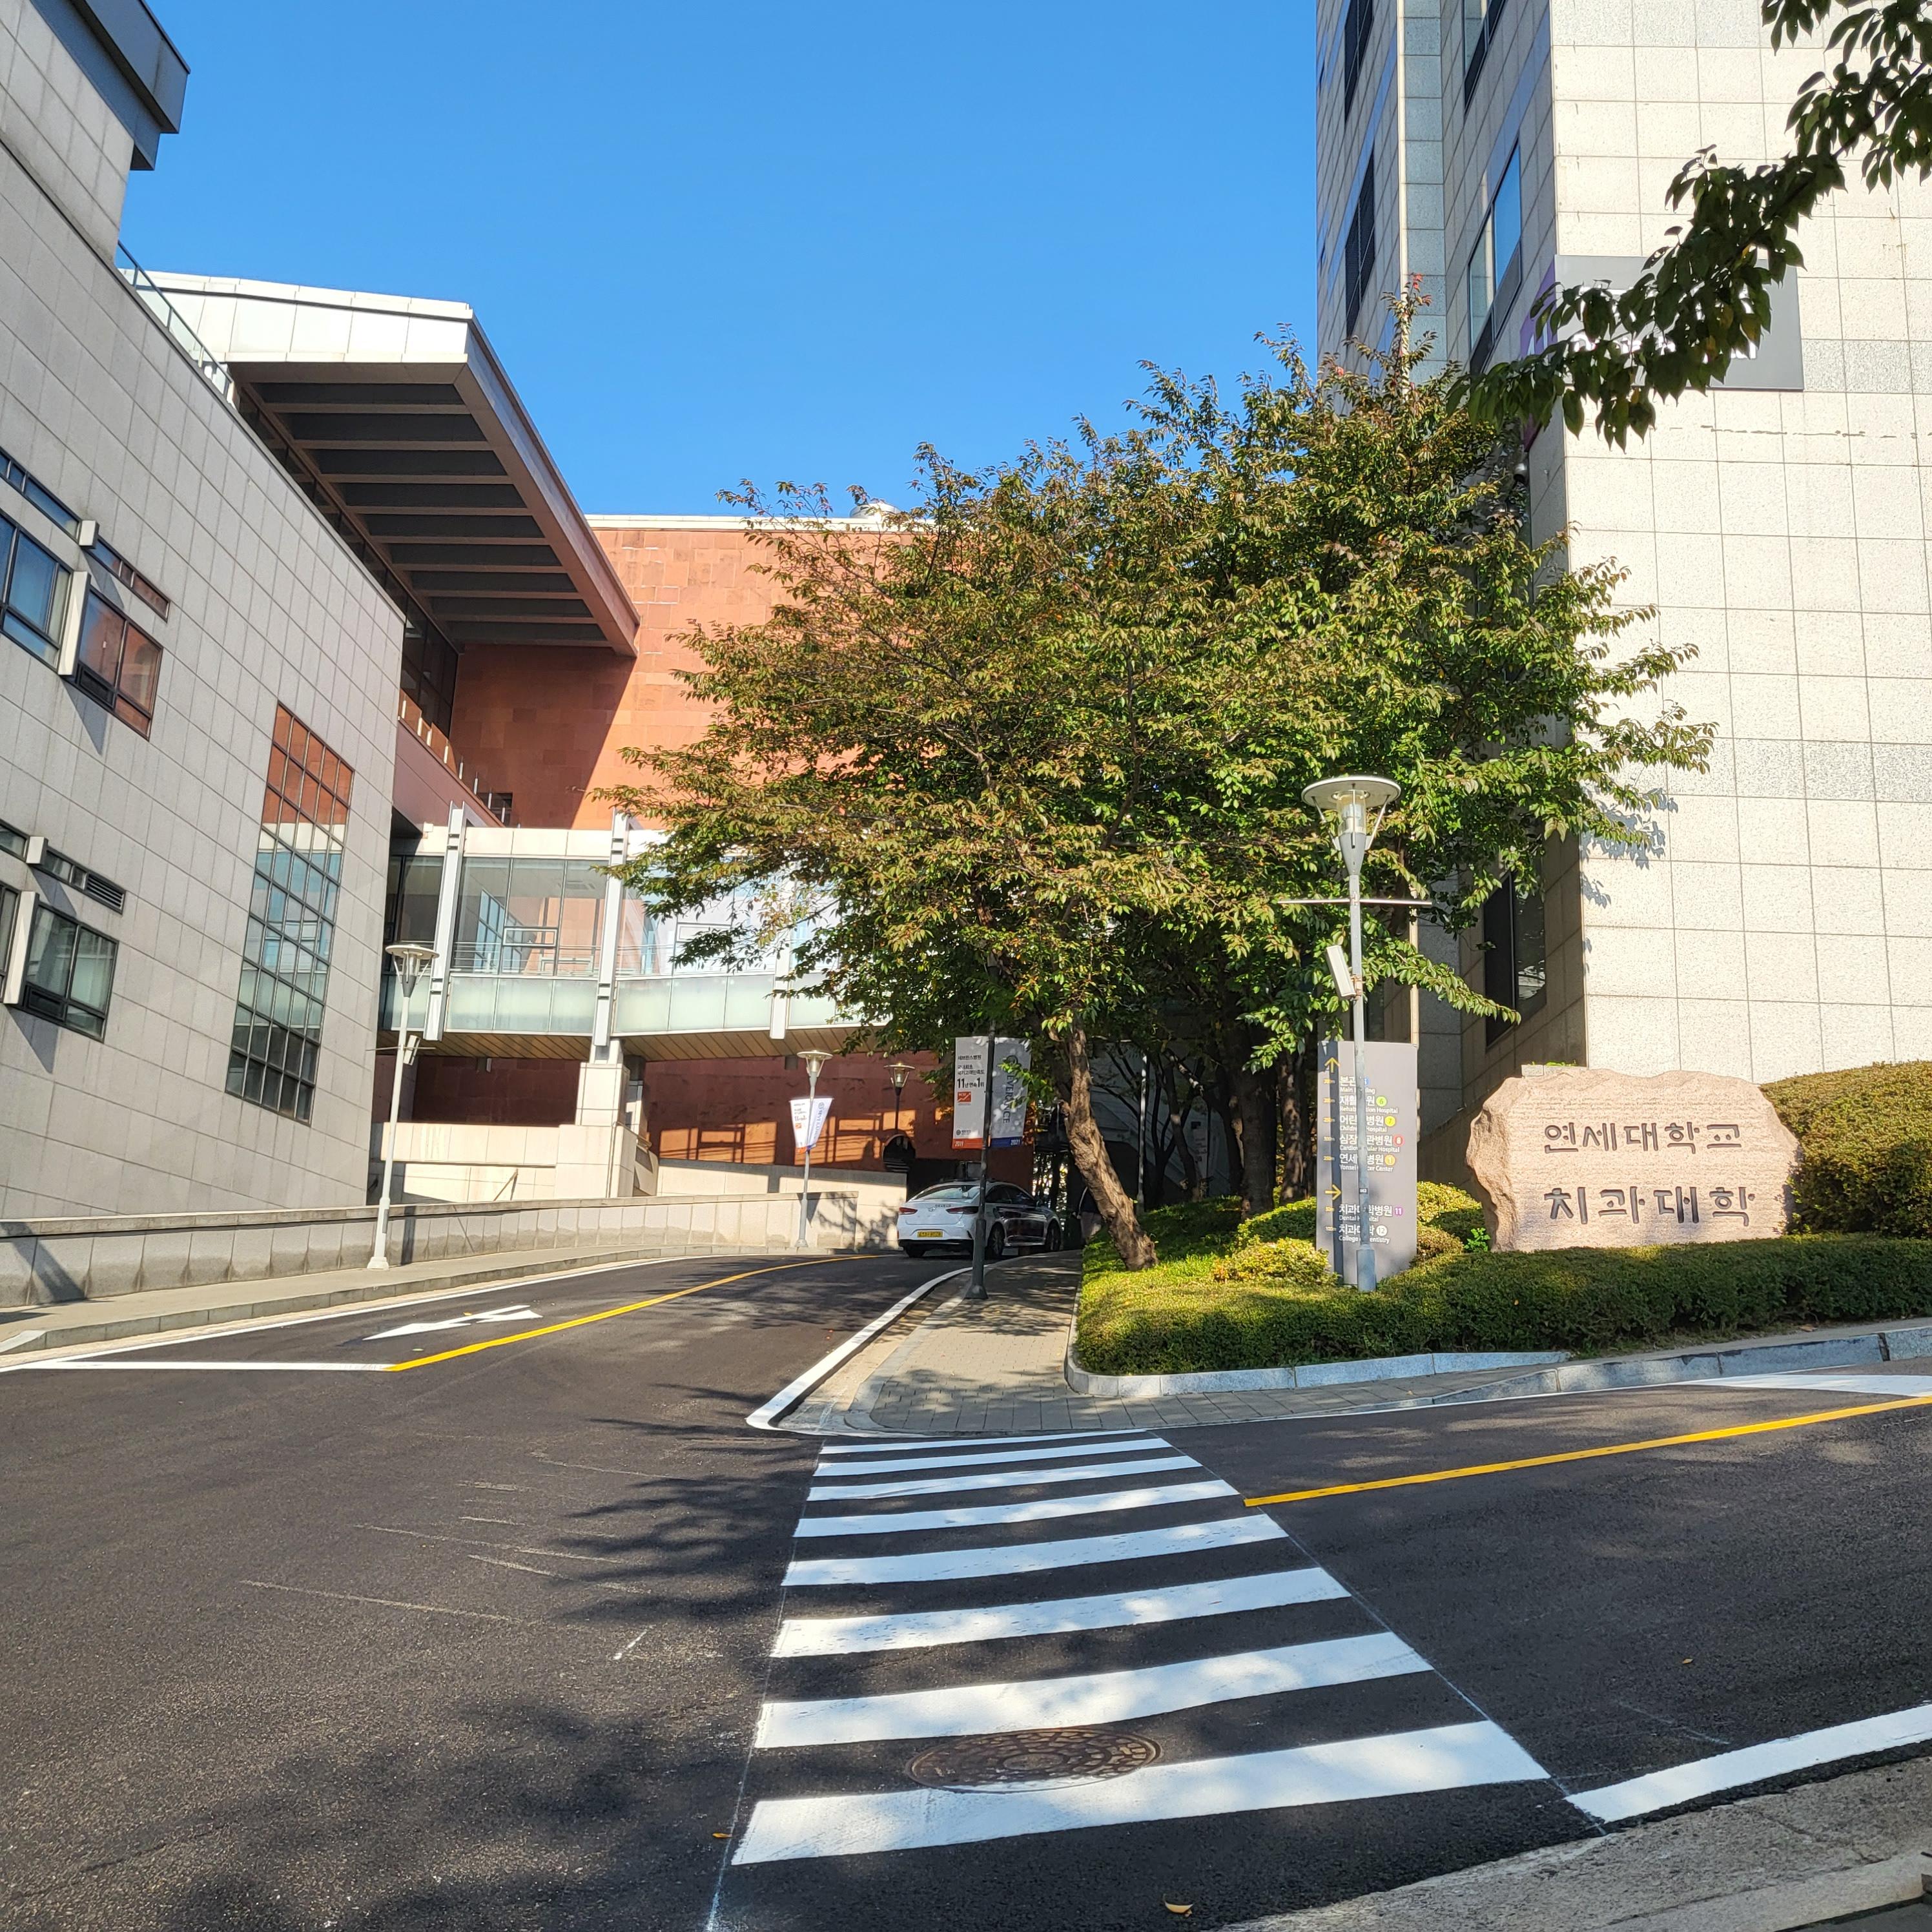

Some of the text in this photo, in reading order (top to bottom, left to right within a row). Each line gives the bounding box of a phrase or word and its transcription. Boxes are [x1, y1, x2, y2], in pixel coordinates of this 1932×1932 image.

[1339, 1095, 1375, 1107] 재활원
[1339, 1115, 1384, 1127] 어린병원
[1339, 1134, 1393, 1146] 심장관병원
[1543, 1122, 1742, 1155] 연세대학교
[1339, 1153, 1384, 1166] 연세병원
[1543, 1186, 1756, 1227] 치과대학
